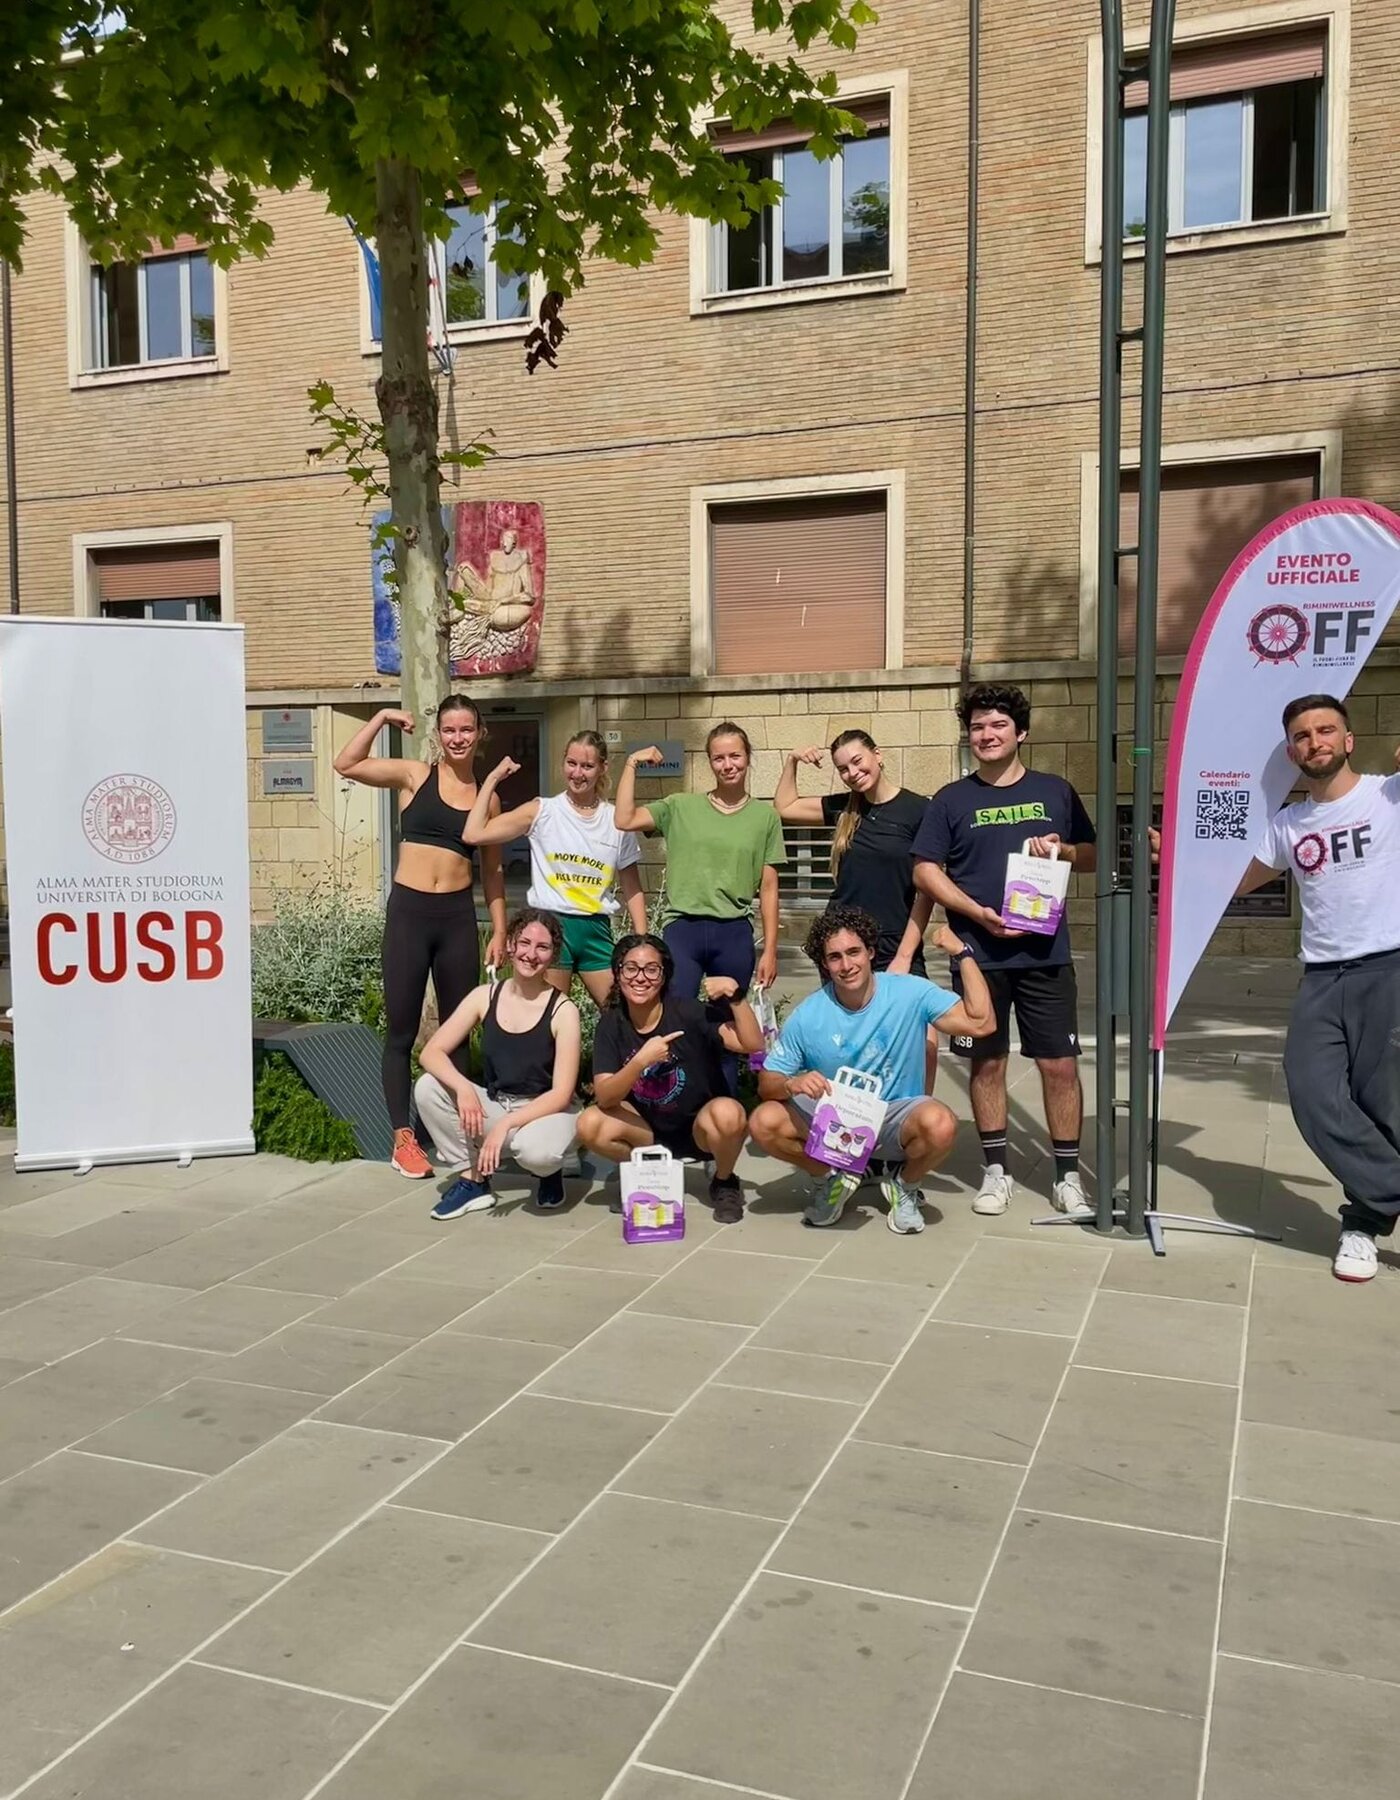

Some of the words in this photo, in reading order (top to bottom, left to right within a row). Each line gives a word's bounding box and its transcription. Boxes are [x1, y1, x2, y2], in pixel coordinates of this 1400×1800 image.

[1277, 552, 1352, 569] EVENTO
[1267, 569, 1360, 585] UFFICIALE
[1302, 600, 1376, 610] RIMINIWELLNESS
[1199, 770, 1251, 779] Calendario
[89, 777, 126, 804] MATER
[132, 777, 174, 841] STUDIORUM
[980, 804, 1044, 823] SAILS
[85, 808, 99, 841] ALMA
[129, 848, 156, 861] 1088
[554, 852, 580, 863] MOVE
[581, 856, 605, 871] MORE
[36, 877, 78, 889] ALMA
[82, 876, 132, 888] MATER
[136, 876, 223, 888] STUDIORUM
[37, 889, 126, 904] UNIVERSITÀ
[131, 890, 147, 902] DI
[152, 890, 223, 901] BOLOGNA
[37, 911, 224, 986] CUSB
